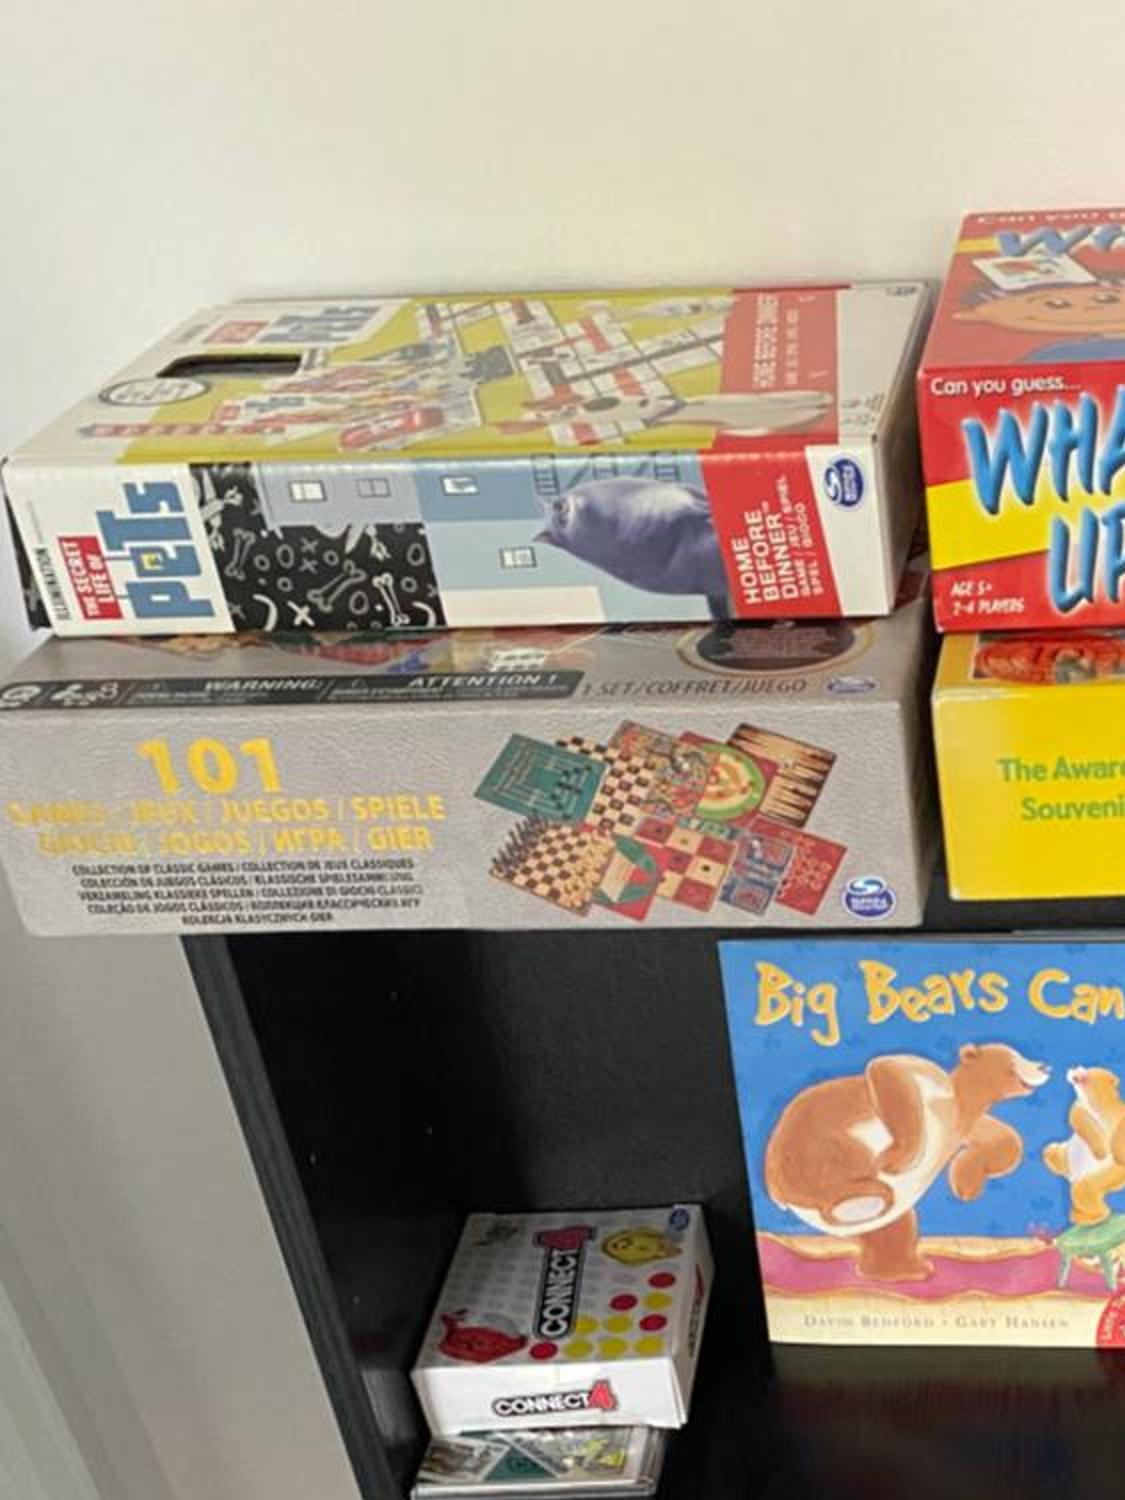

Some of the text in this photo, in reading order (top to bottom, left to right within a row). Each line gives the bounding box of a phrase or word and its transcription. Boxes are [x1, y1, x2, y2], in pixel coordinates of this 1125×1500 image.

[931, 377, 967, 396] Can
[974, 378, 1008, 398] you
[776, 475, 812, 597] GAME JEU SPIEL
[794, 502, 824, 596] SPEL GIOCO
[62, 540, 94, 595] SECRET
[744, 508, 781, 602] BEFORE
[731, 537, 763, 605] HOME
[91, 574, 113, 603] LIFE
[951, 583, 973, 597] AGE
[952, 599, 1025, 616] 2-4 PLAYERS
[204, 678, 324, 692] WARNING:
[409, 675, 543, 687] ATTENTION
[136, 735, 283, 796] 101
[1001, 756, 1047, 782] The
[131, 800, 197, 824] JEUX
[219, 799, 329, 823] JUEGOS
[351, 796, 447, 822] SPIELE
[160, 829, 250, 856] JOGOS
[366, 825, 434, 851] GIER
[754, 961, 842, 1047] Big
[858, 959, 1010, 1027] Bears
[541, 1248, 580, 1337] CONNECT
[493, 1390, 592, 1417] CONNECT
